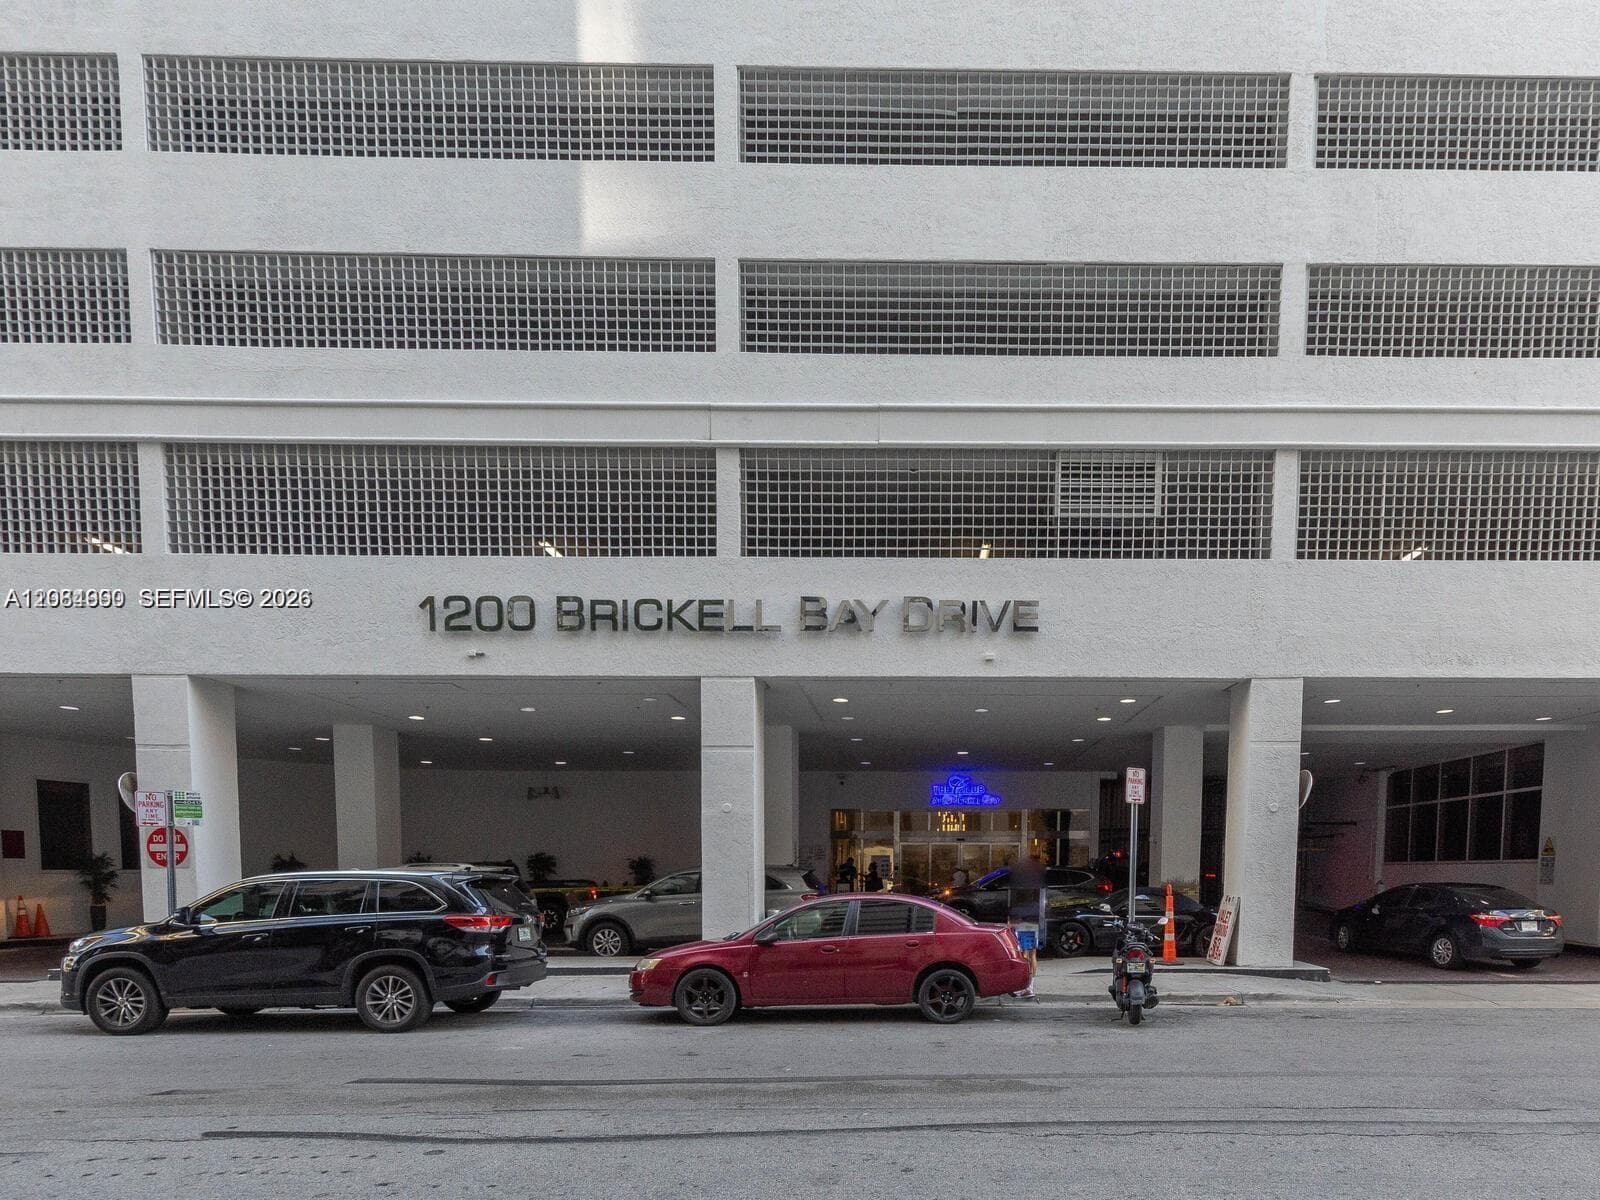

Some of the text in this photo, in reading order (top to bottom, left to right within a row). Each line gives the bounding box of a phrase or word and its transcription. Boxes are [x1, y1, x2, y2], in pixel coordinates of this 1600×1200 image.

[418, 595, 1039, 632] 1200 BRICKELL BAY DRIVE
[145, 793, 157, 801] NO
[156, 853, 180, 861] ENR
